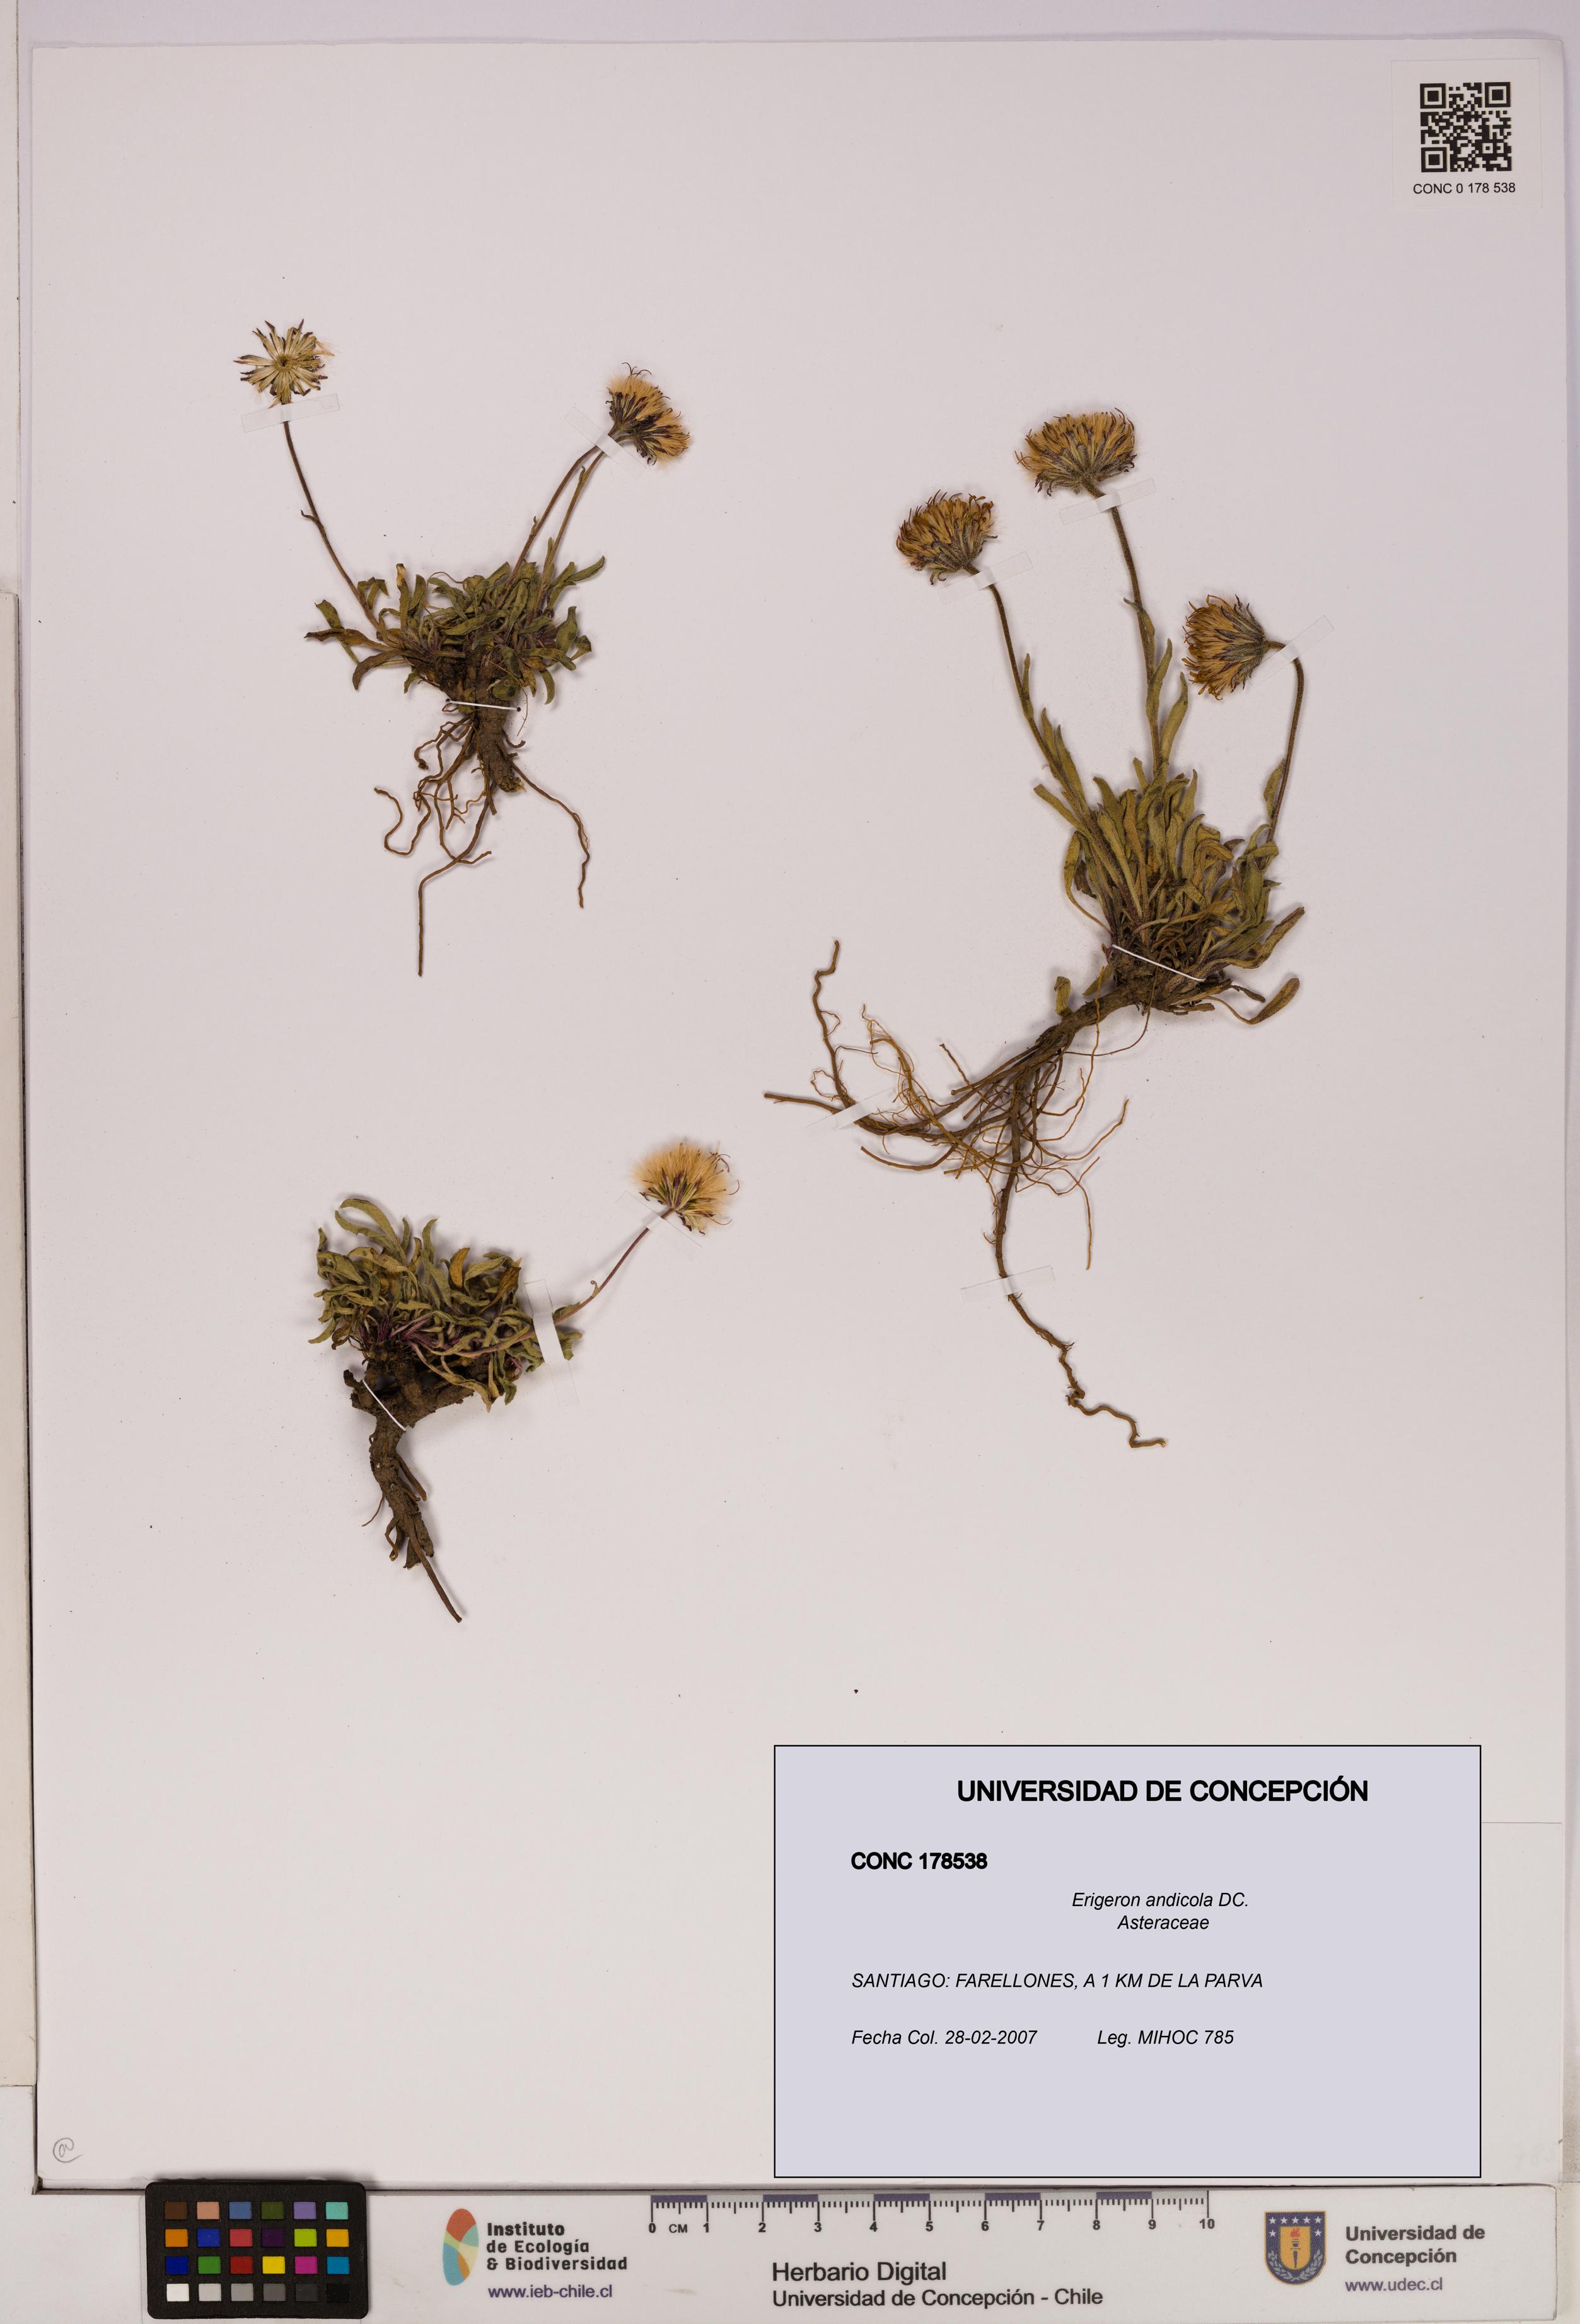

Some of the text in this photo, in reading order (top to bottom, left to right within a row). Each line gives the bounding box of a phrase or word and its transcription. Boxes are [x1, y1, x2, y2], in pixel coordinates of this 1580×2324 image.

[1413, 182, 1516, 194] CONC 0 178 538
[487, 2221, 565, 2236] Instituto
[649, 2219, 1215, 2233] 0 CM 1 2 3 4 5 6 7 8 9 10
[1345, 2224, 1485, 2241] Universidad de
[486, 2239, 590, 2256] de Ecología
[487, 2256, 627, 2270] & Biodiversidad
[1345, 2248, 1457, 2267] Concepción
[772, 2261, 946, 2286] Herbario Digital
[487, 2284, 612, 2298] www.ieb-chile.cl
[1344, 2277, 1443, 2292] www.udec.cl
[773, 2289, 885, 2307] Universidad
[891, 2289, 915, 2306] de
[921, 2289, 1035, 2310] Concepción
[1054, 2288, 1103, 2305] Chile
